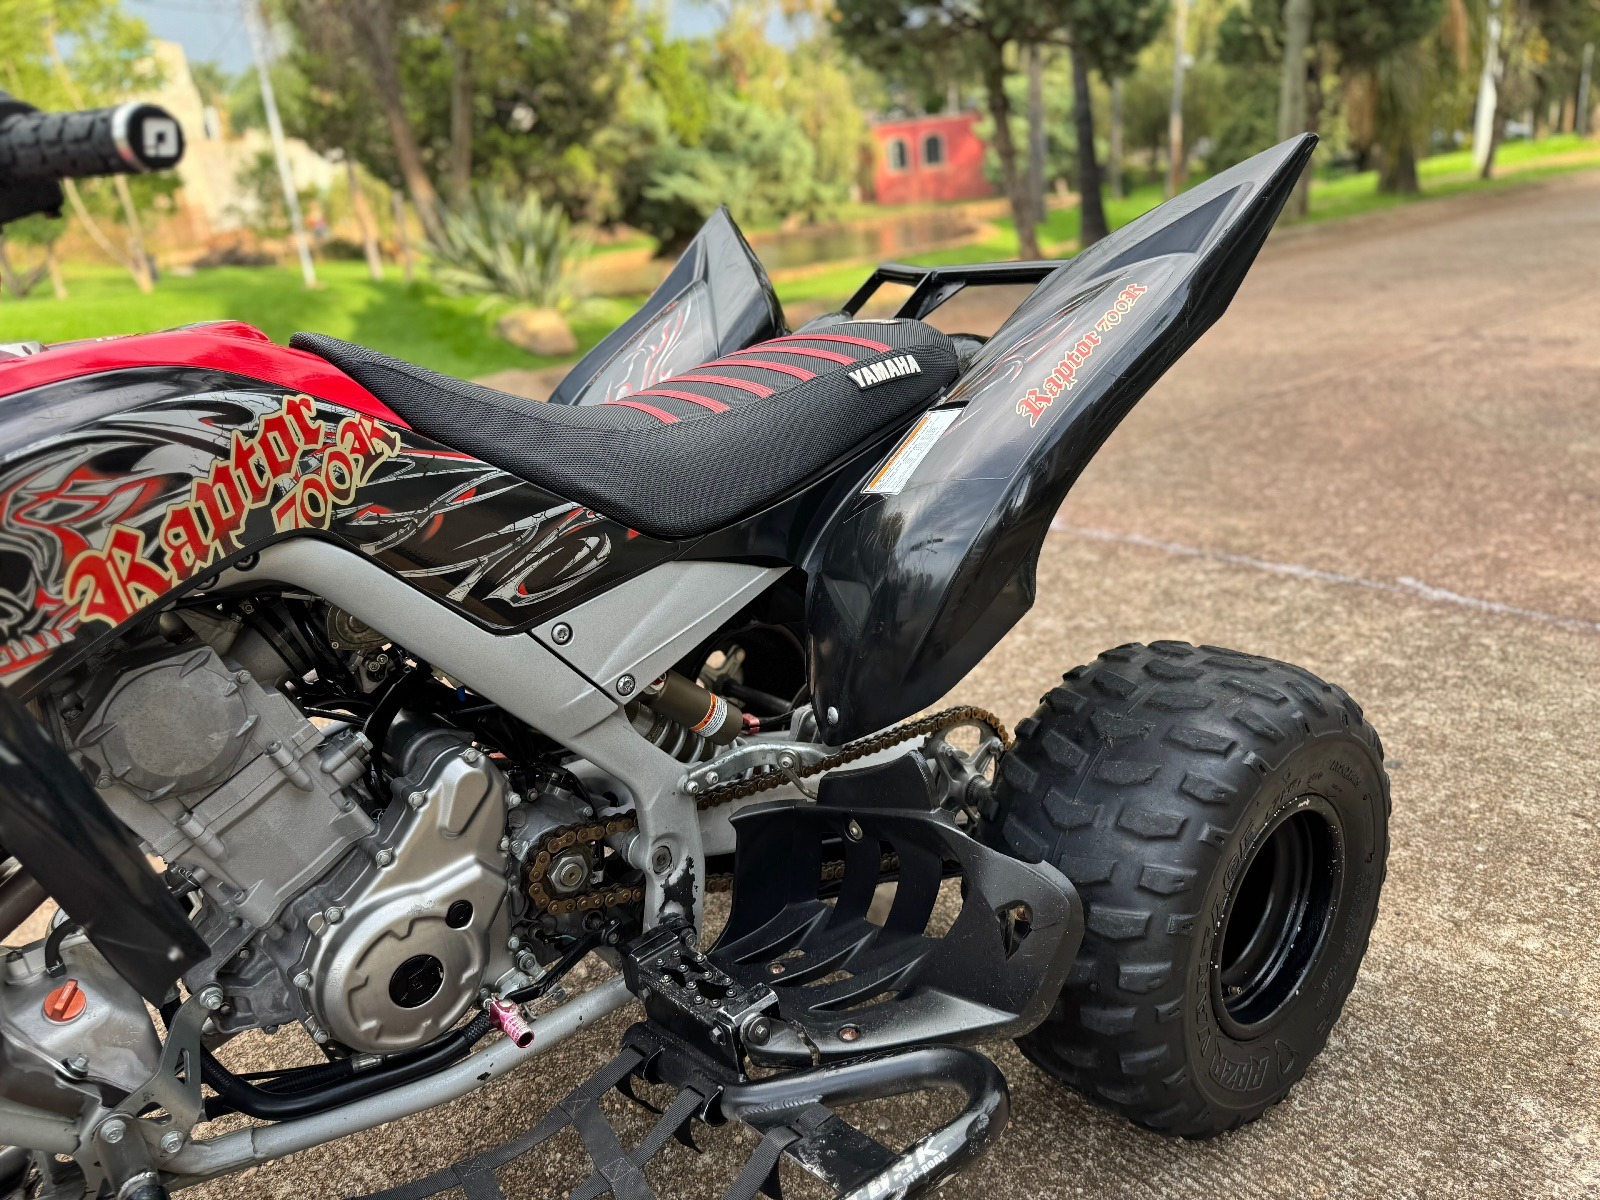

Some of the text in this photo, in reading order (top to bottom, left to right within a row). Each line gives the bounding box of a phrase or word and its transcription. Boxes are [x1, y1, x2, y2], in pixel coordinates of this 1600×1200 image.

[848, 355, 921, 388] YAMAHA
[1016, 283, 1148, 427] Raptor 700R
[63, 394, 326, 627] Raptor
[272, 412, 401, 533] 700R
[903, 1151, 948, 1186] OFF-ROAD
